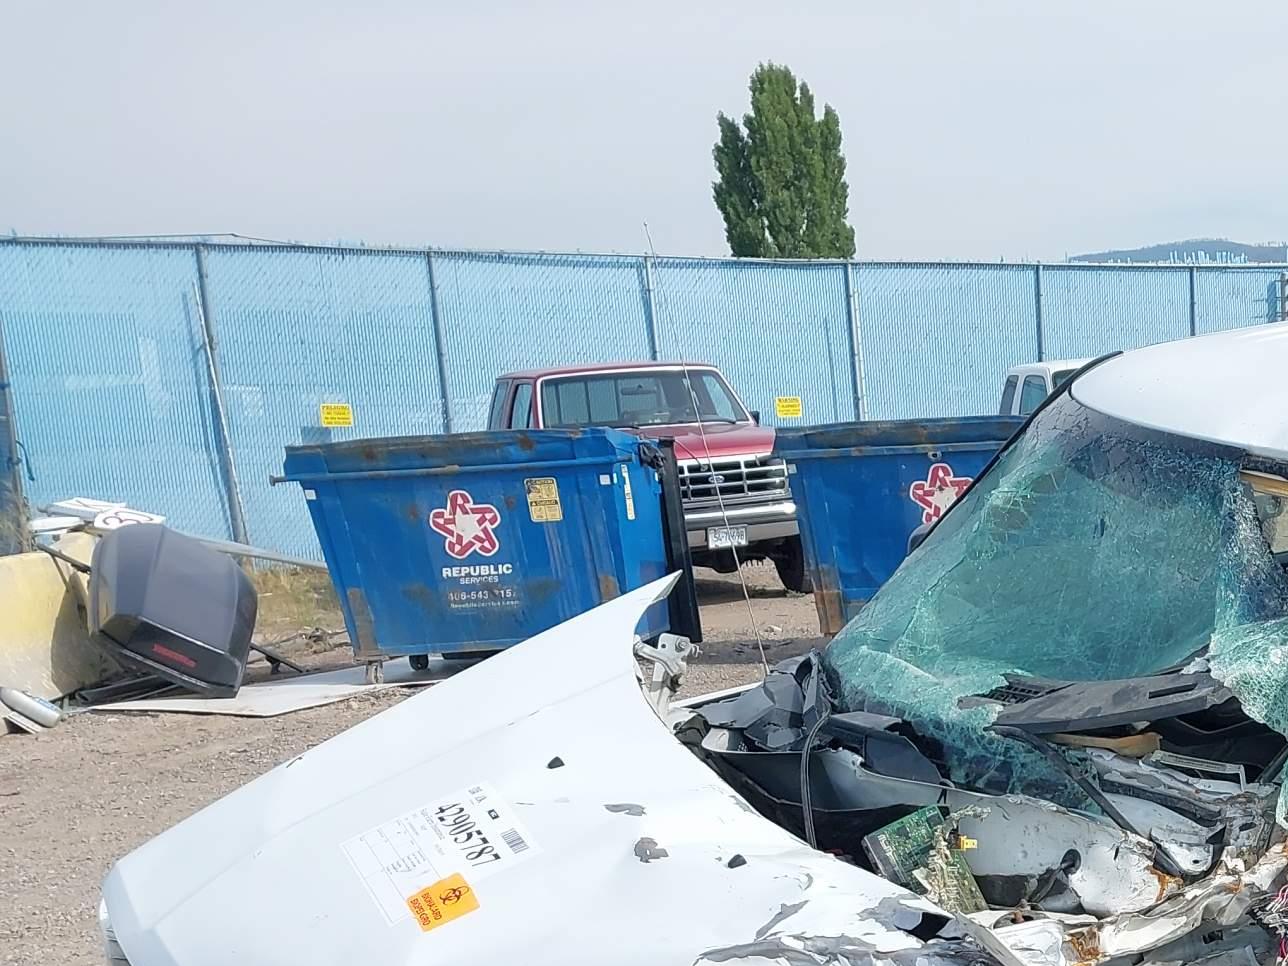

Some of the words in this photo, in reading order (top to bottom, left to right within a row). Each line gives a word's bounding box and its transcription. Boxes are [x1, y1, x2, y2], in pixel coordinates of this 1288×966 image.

[442, 563, 513, 577] REPUBLIC
[459, 575, 499, 585] SERVICES
[435, 803, 501, 867] 42905787
